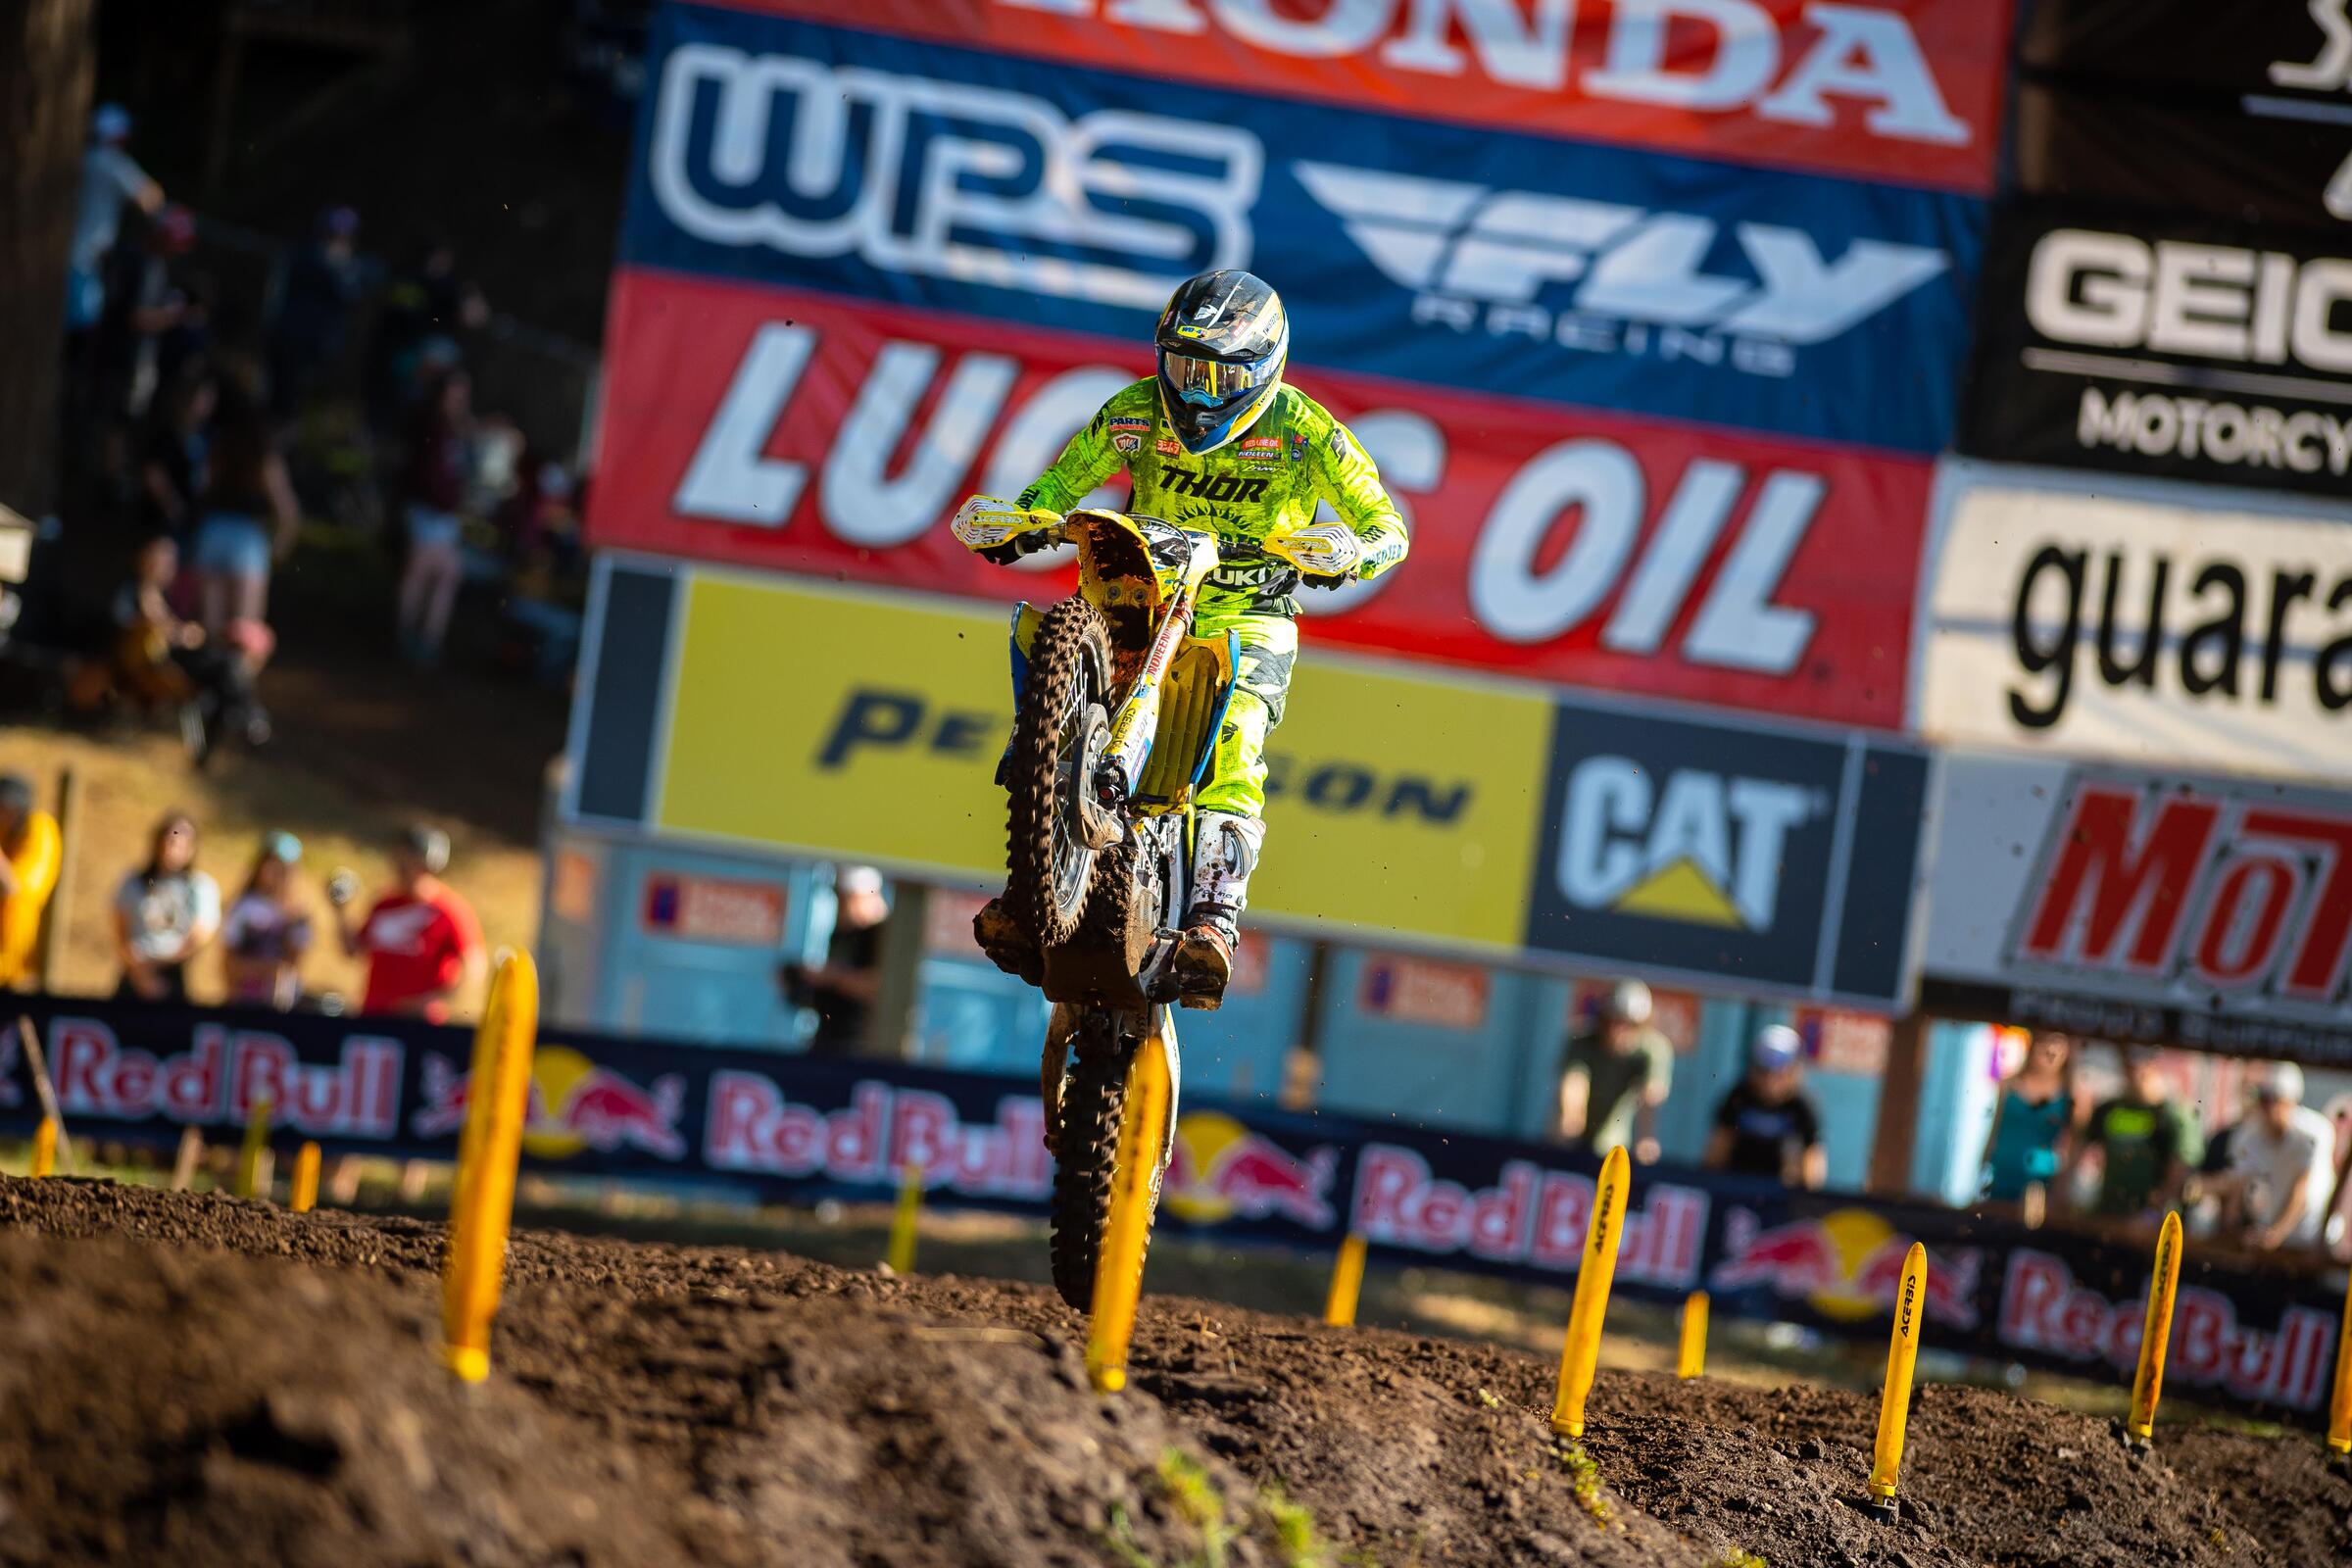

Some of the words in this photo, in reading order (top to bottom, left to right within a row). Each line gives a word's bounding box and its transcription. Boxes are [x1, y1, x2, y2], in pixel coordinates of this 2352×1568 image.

[995, 0, 1973, 145] NDA
[650, 42, 1265, 306] WPS
[1291, 160, 1952, 345] FLY
[1412, 297, 1796, 377] RACING
[673, 321, 1446, 615] LUC
[1468, 438, 1826, 675] OIL
[1159, 465, 1270, 503] THOR
[1146, 630, 1171, 677] NOLEEN
[1556, 753, 1818, 933] CAT
[50, 1017, 226, 1121] Red
[231, 1030, 404, 1139] Bull
[704, 1069, 887, 1176] Red
[887, 1087, 1056, 1201] Bull
[1350, 1143, 1535, 1264] Red
[1900, 1274, 1917, 1338] ACERBIS
[2164, 1284, 2337, 1410] Bull
